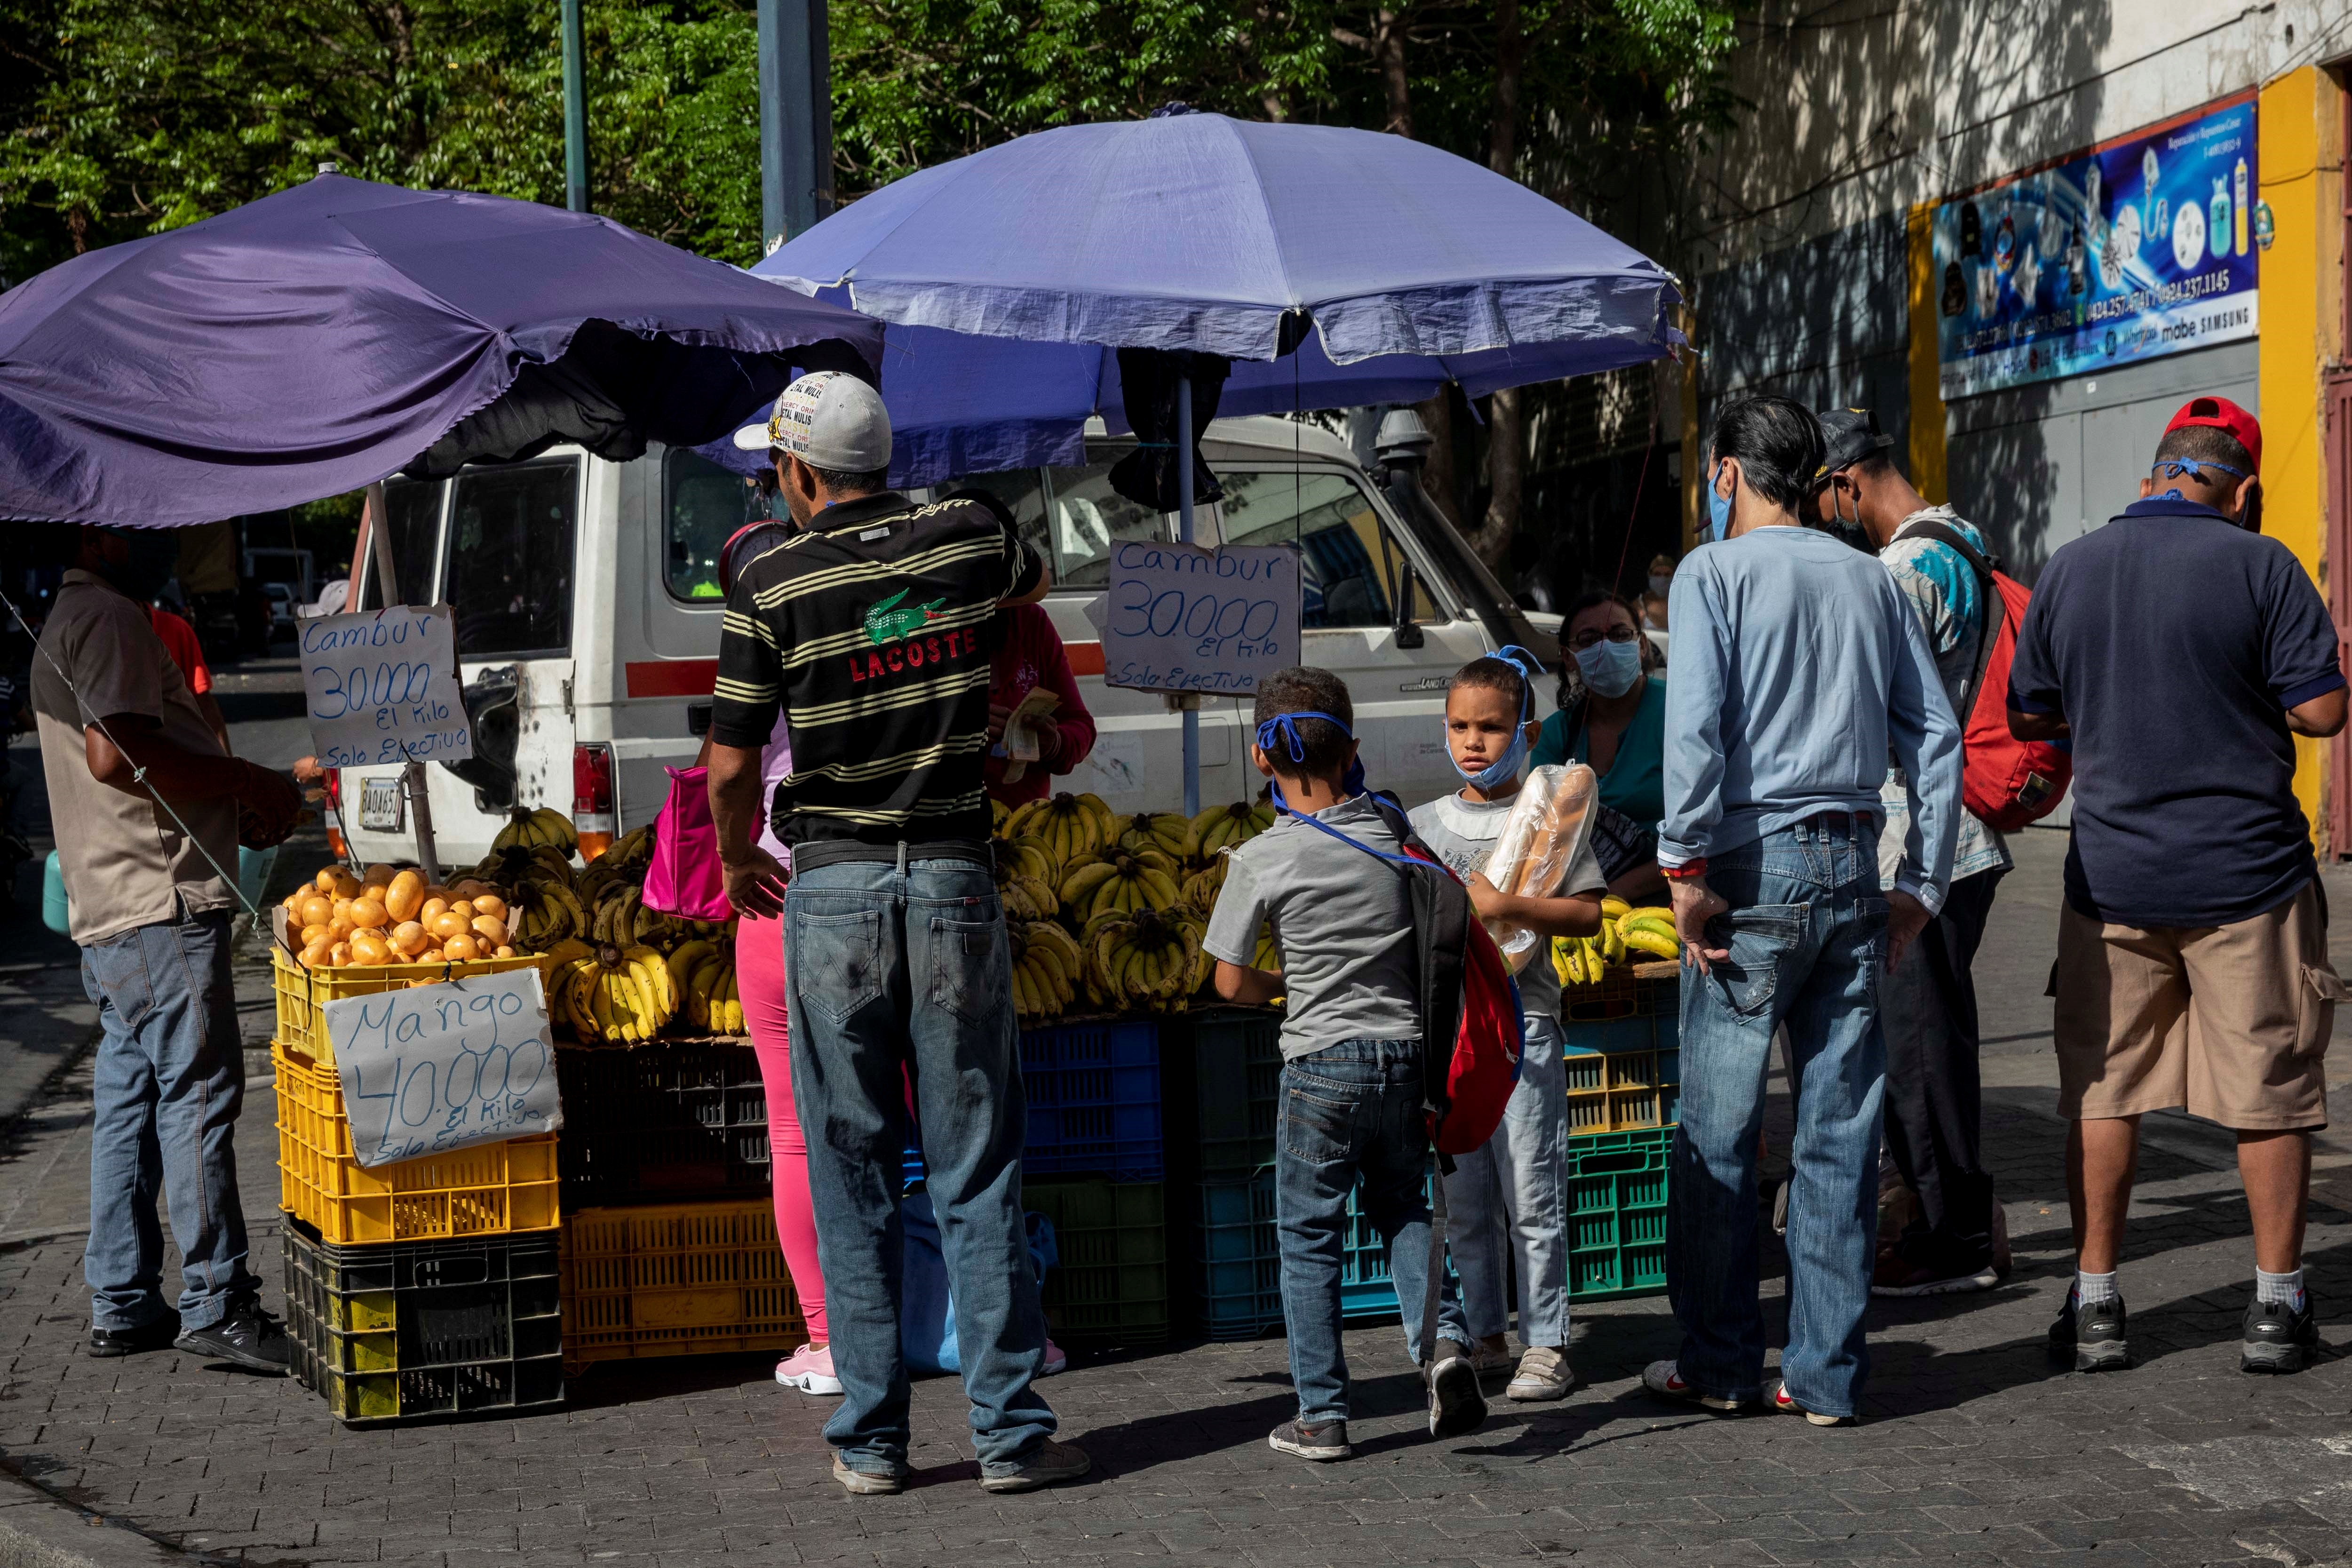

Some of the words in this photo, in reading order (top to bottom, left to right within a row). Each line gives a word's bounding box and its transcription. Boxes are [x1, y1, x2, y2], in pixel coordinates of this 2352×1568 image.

[2161, 317, 2196, 343] mabe
[2200, 307, 2249, 334] SAMSUNG
[1118, 543, 1281, 580] Cambur
[1113, 580, 1279, 641] 30.000
[303, 615, 430, 653] Cambur
[1196, 637, 1224, 657] El
[849, 628, 977, 682] LACOSTE
[312, 661, 430, 719] 30.000
[1116, 662, 1158, 686] Solo
[376, 707, 398, 730] El
[413, 700, 449, 724] Kilo
[325, 745, 366, 767] Solo
[347, 992, 522, 1056] Mango
[355, 1038, 546, 1146] 40.000
[445, 1106, 468, 1129] El
[481, 1093, 525, 1122] Kilo
[373, 1136, 424, 1161] Solo
